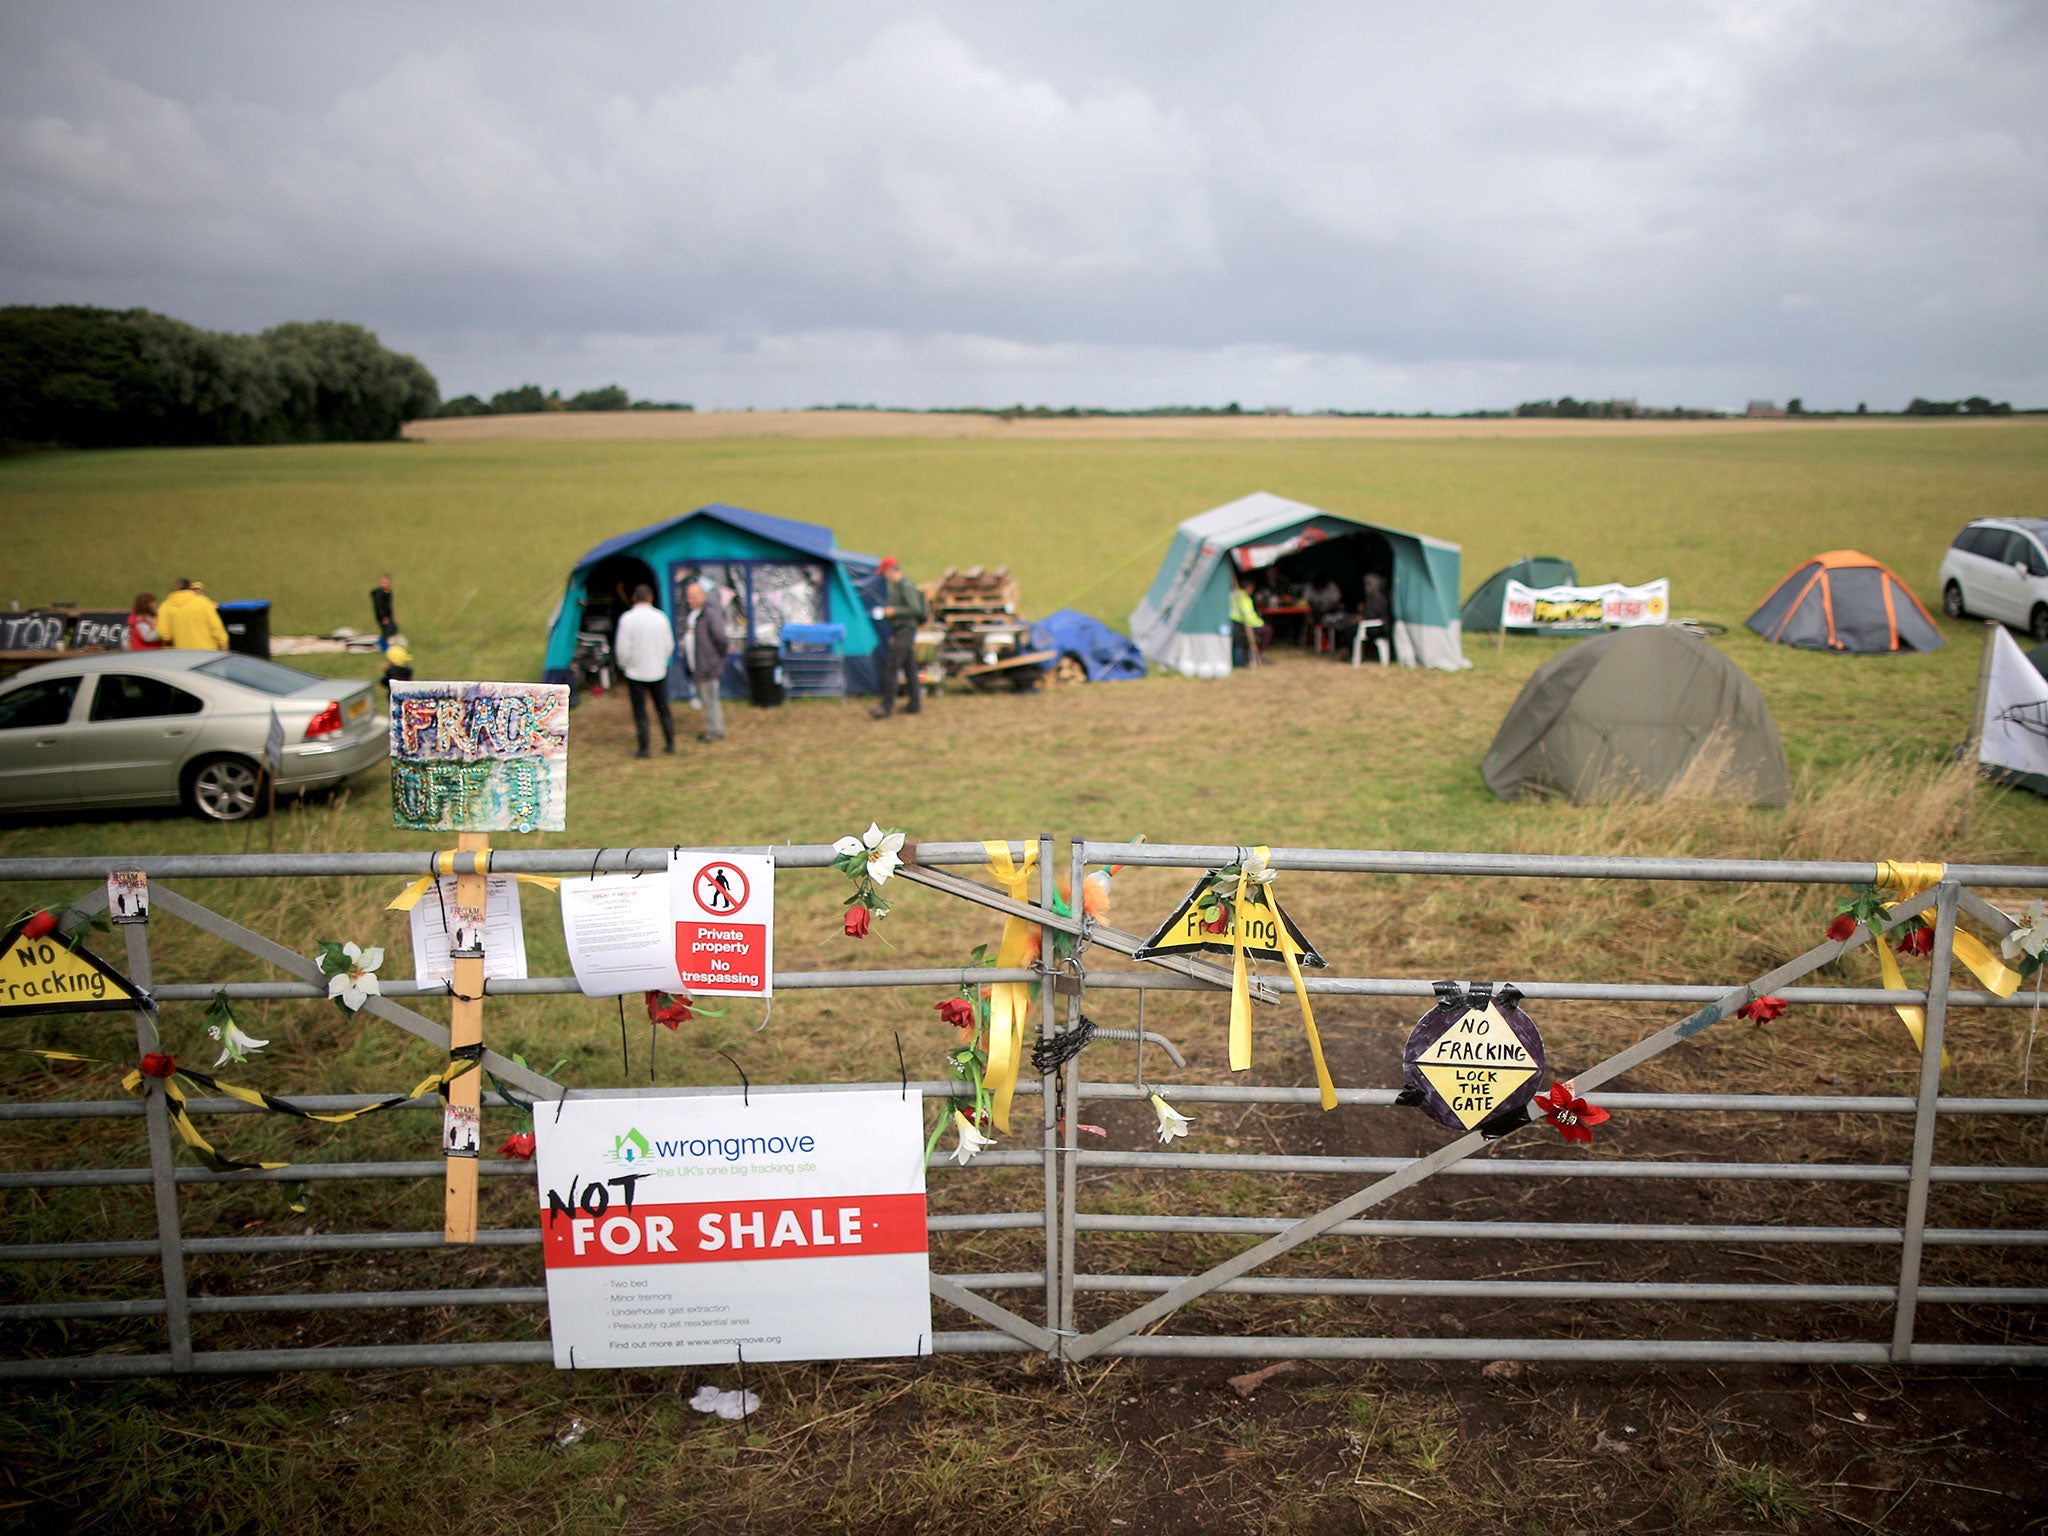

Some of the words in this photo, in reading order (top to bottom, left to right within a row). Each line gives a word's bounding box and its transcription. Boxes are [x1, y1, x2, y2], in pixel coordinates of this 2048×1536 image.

[0, 617, 62, 649] TOP
[401, 694, 565, 755] FRACK
[697, 927, 744, 941] Private
[1187, 911, 1278, 949] Fring
[15, 944, 56, 968] NO
[692, 942, 750, 955] property
[711, 959, 730, 971] No
[682, 970, 759, 986] trespassing
[1459, 1018, 1490, 1036] NO
[1436, 1040, 1527, 1062] FRACKING
[1455, 1070, 1498, 1083] LOCK
[1459, 1083, 1490, 1095] THE
[1452, 1096, 1494, 1111] GATE
[655, 1135, 815, 1161] wrongmove
[656, 1167, 675, 1177] the
[677, 1165, 704, 1177] UK's
[706, 1166, 728, 1176] one
[730, 1164, 748, 1176] big
[797, 1162, 817, 1173] site
[546, 1173, 657, 1229] NOT
[571, 1215, 680, 1257] FOR
[698, 1207, 863, 1252] SHALE
[610, 1280, 628, 1288] Two
[630, 1279, 648, 1288] bed
[611, 1294, 635, 1302] Minor
[638, 1293, 672, 1301] tremors
[611, 1307, 666, 1317] Underhouse
[668, 1307, 685, 1316] gas
[687, 1304, 730, 1313] extraction
[613, 1321, 657, 1331] Previously
[660, 1320, 681, 1329] quiet
[684, 1318, 728, 1327] residential
[730, 1318, 750, 1326] area
[609, 1341, 629, 1349] Find
[632, 1341, 647, 1349] out
[649, 1340, 673, 1348] more
[675, 1339, 684, 1347] at
[687, 1336, 781, 1346] www.wrongmove.org
